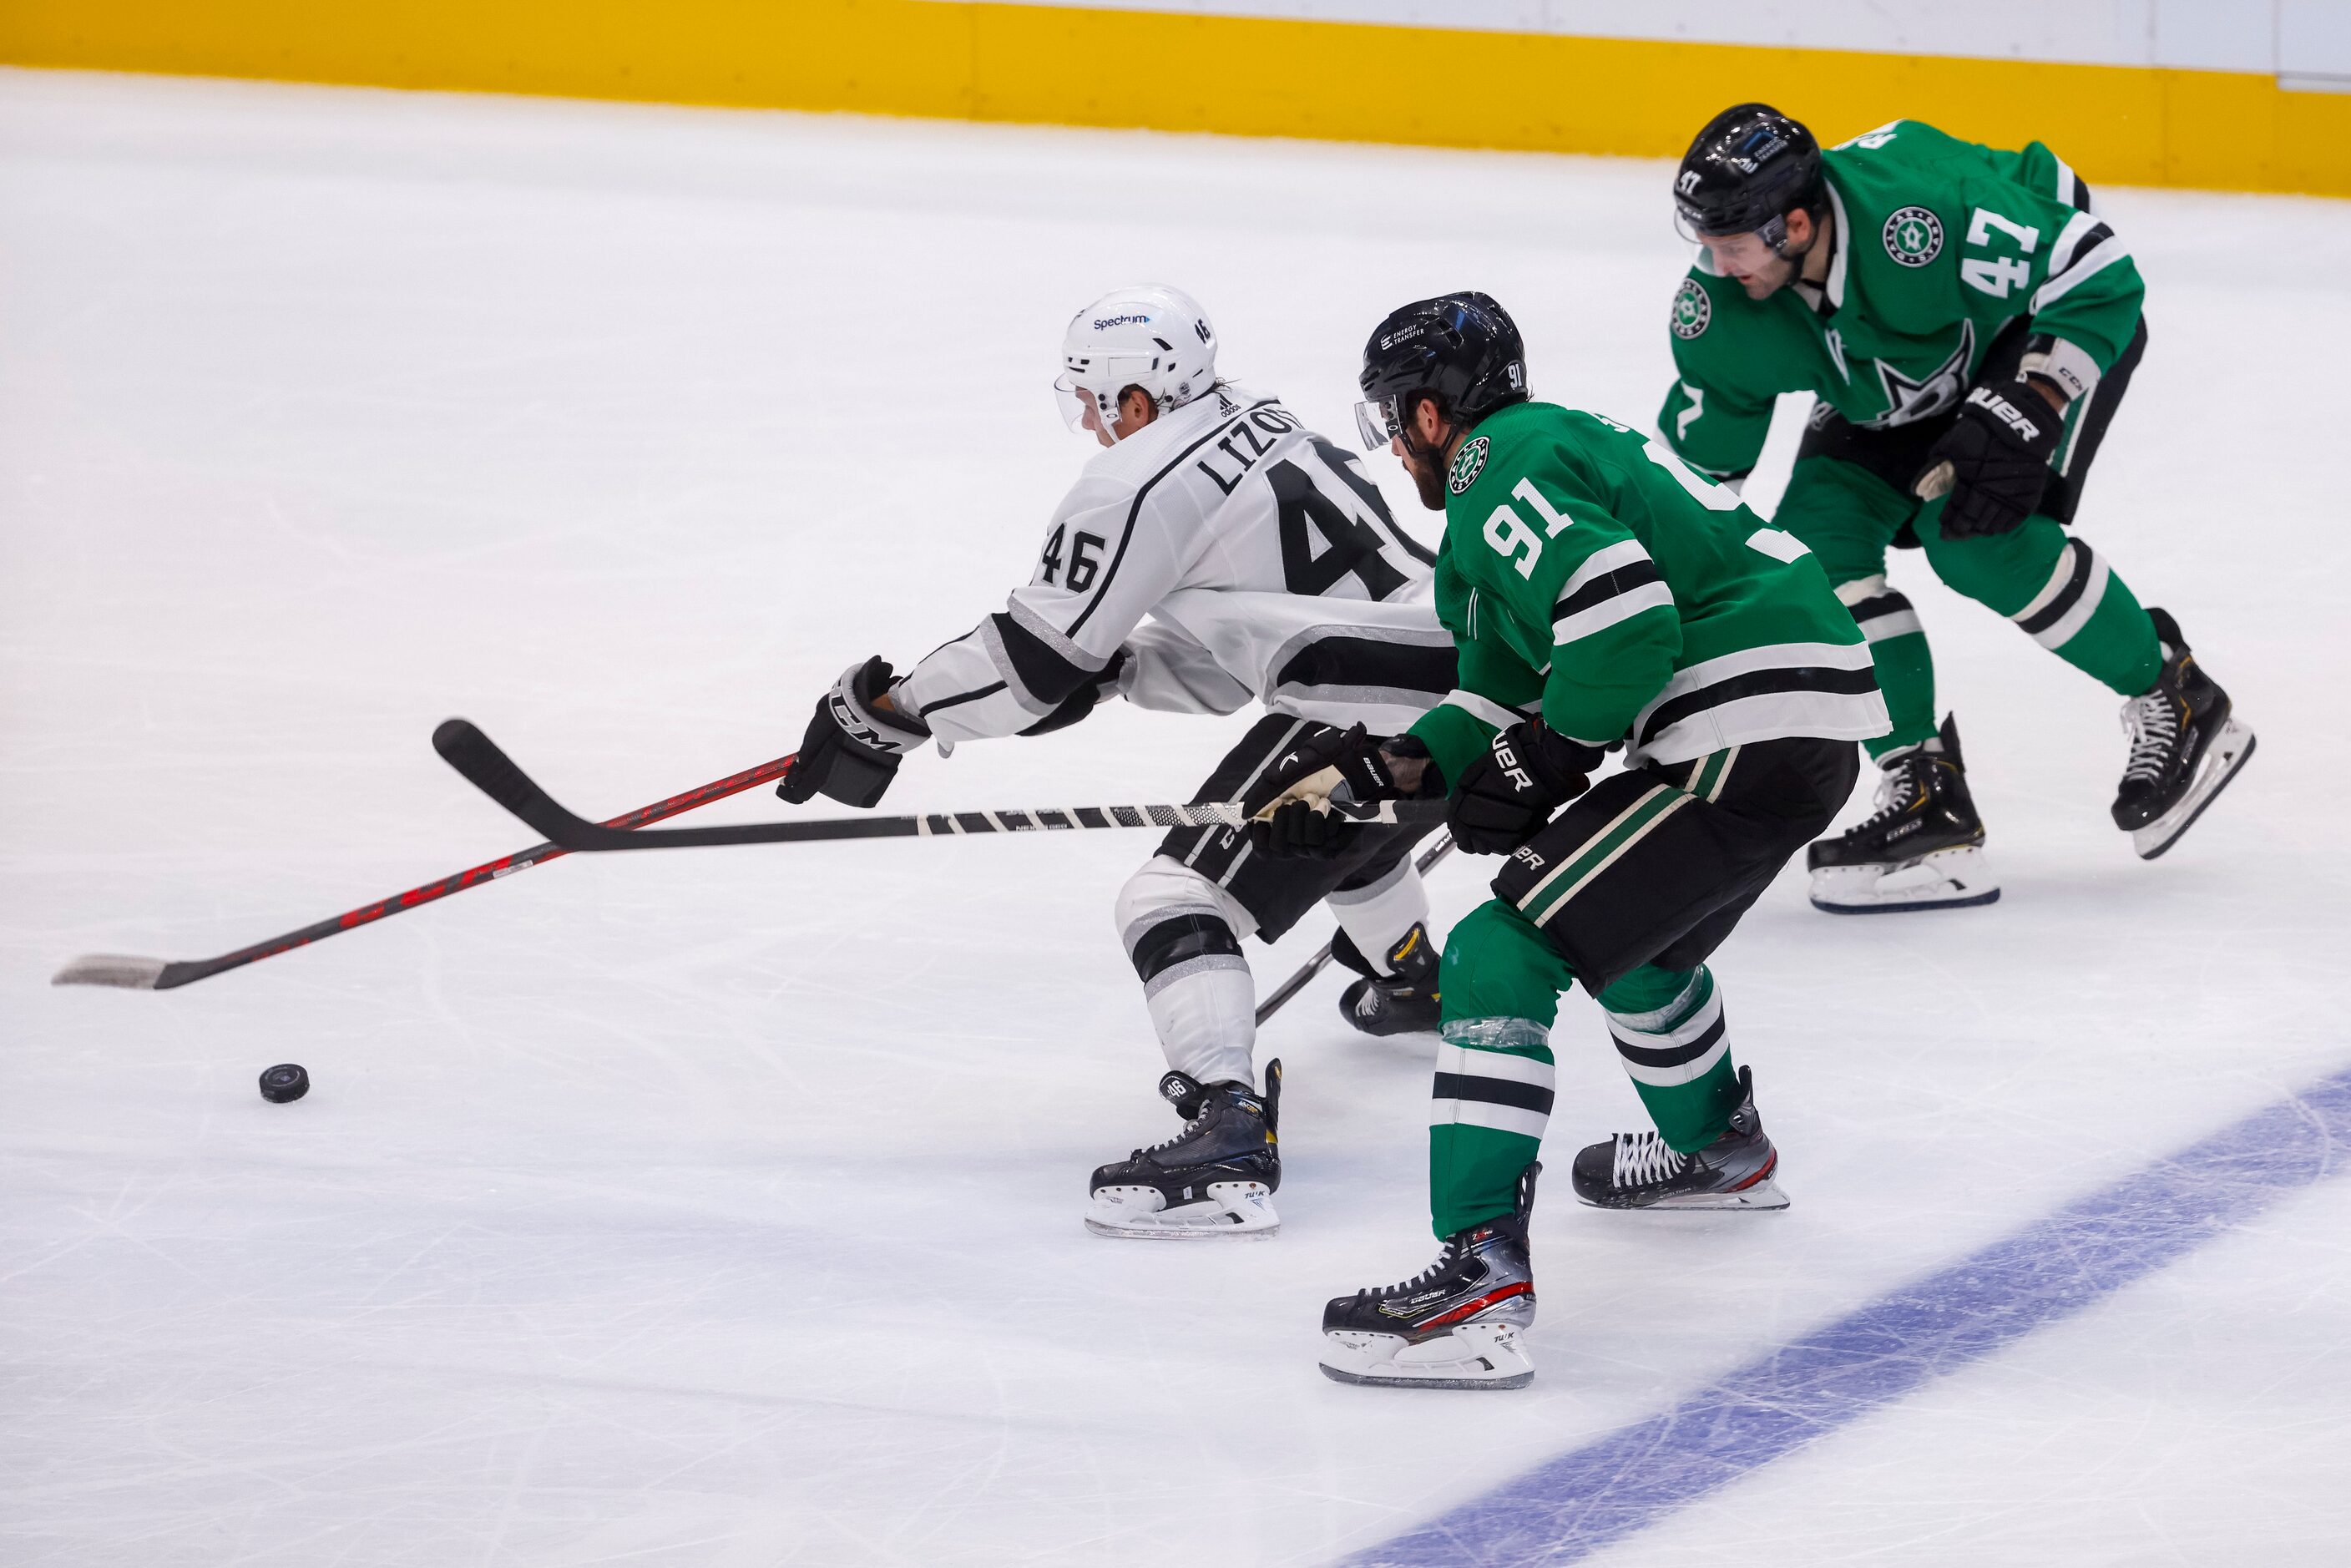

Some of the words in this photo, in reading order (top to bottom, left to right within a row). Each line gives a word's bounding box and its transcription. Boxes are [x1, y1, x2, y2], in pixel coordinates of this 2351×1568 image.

[1681, 170, 1701, 195] 47
[1961, 207, 2040, 298] 47
[1095, 315, 1147, 331] Spectrum
[1195, 318, 1211, 344] 46
[1393, 324, 1418, 338] ENERGY
[1394, 329, 1424, 345] TRANSFER
[1508, 364, 1523, 387] 91
[1221, 404, 1241, 417] adidas
[1677, 380, 1704, 441] 7
[1196, 409, 1299, 497] LIZO
[1451, 439, 1484, 484] DALLAS
[1457, 448, 1486, 489] STARS
[1483, 477, 1574, 580] 91
[1040, 523, 1107, 594] 46
[1363, 757, 1384, 787] BAUER
[1493, 731, 1534, 793] UER
[1167, 1080, 1186, 1097] 46
